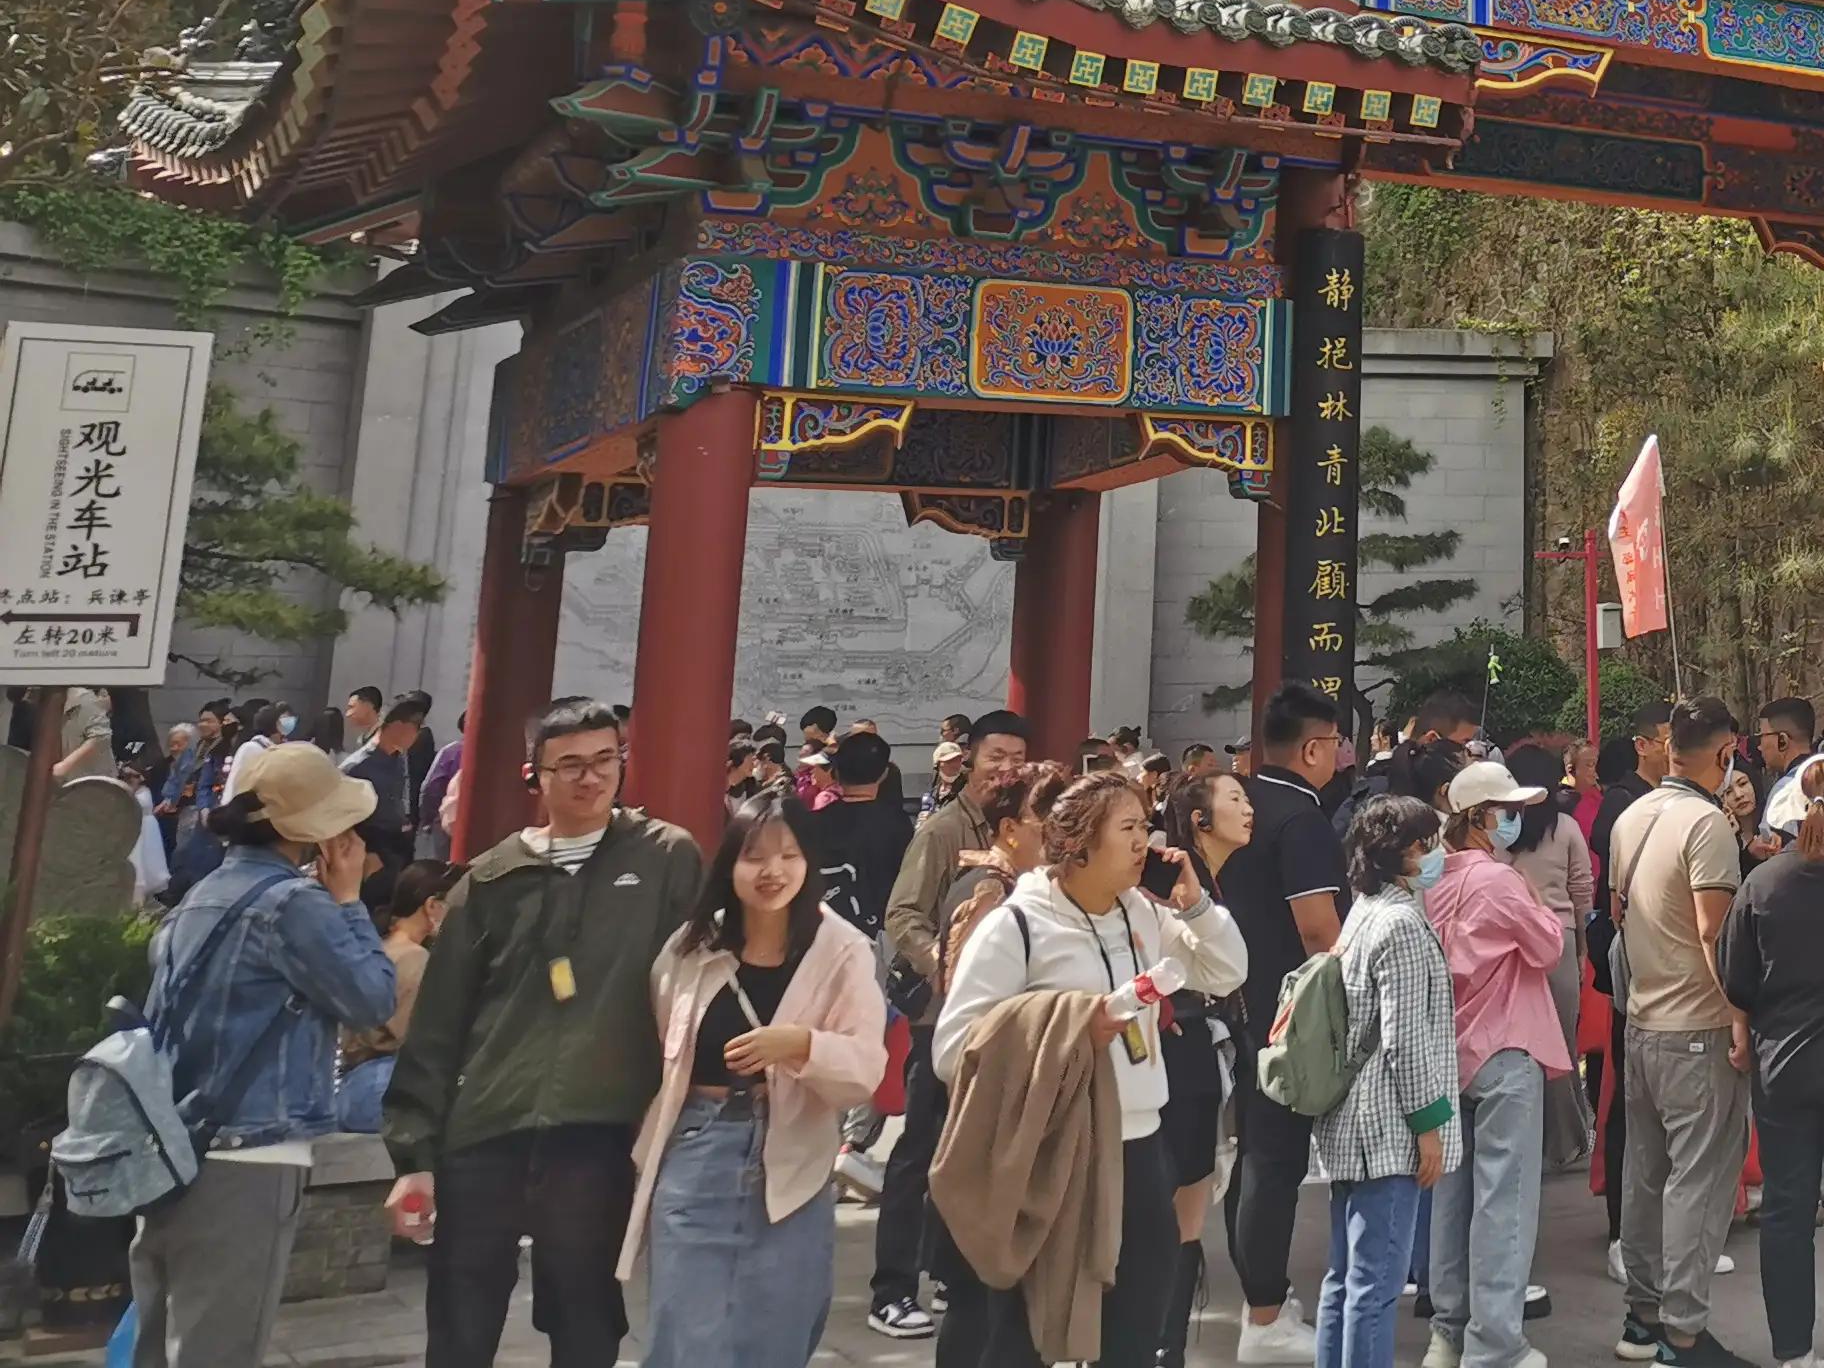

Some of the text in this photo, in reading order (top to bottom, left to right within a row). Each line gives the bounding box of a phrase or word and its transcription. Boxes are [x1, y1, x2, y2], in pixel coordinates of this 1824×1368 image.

[51, 428, 72, 497] SIGHTSEEING
[56, 420, 127, 580] 观光车站
[46, 512, 60, 532] THE
[40, 533, 57, 579] STATION
[14, 625, 119, 646] 左转20米
[62, 649, 76, 658] 20
